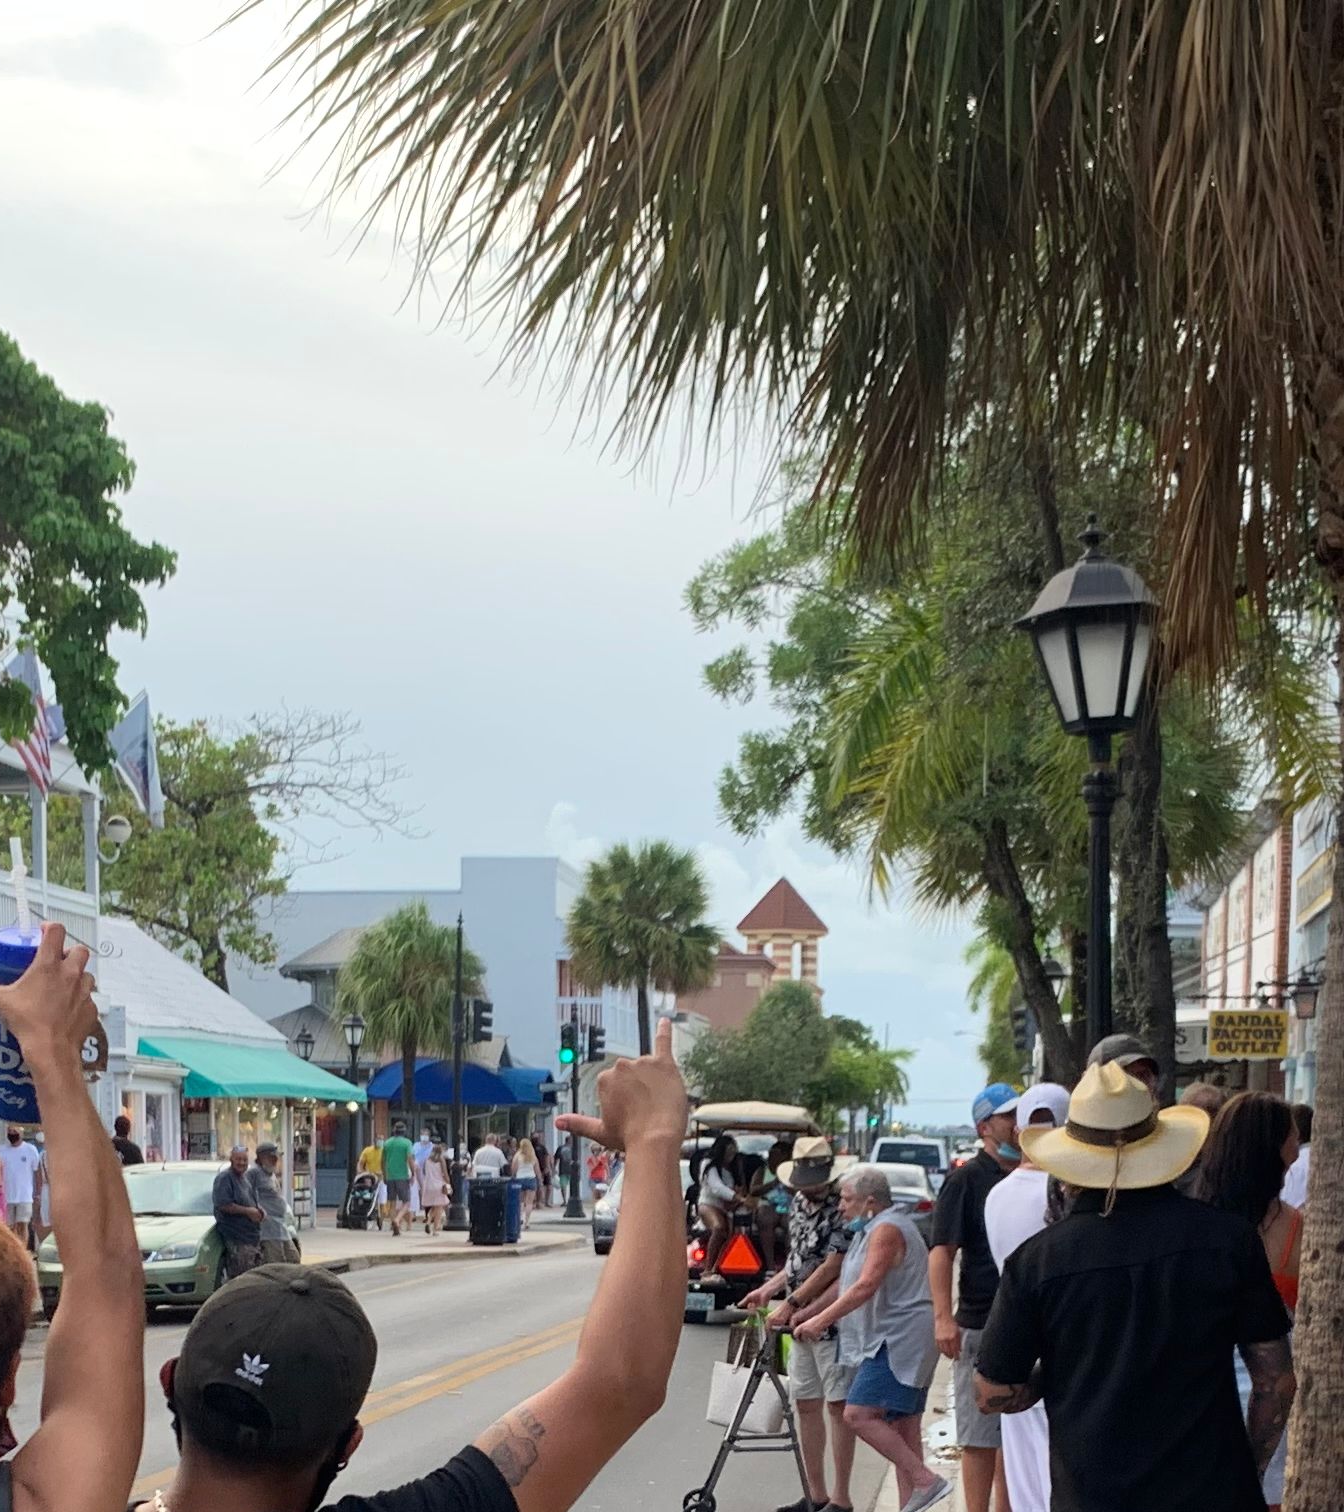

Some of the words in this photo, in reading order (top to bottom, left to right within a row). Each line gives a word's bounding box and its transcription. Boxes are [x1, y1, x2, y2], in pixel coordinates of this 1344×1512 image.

[1215, 1015, 1284, 1027] SANDAL
[1212, 1028, 1285, 1040] FACTORY
[1216, 1041, 1281, 1053] OUTLET
